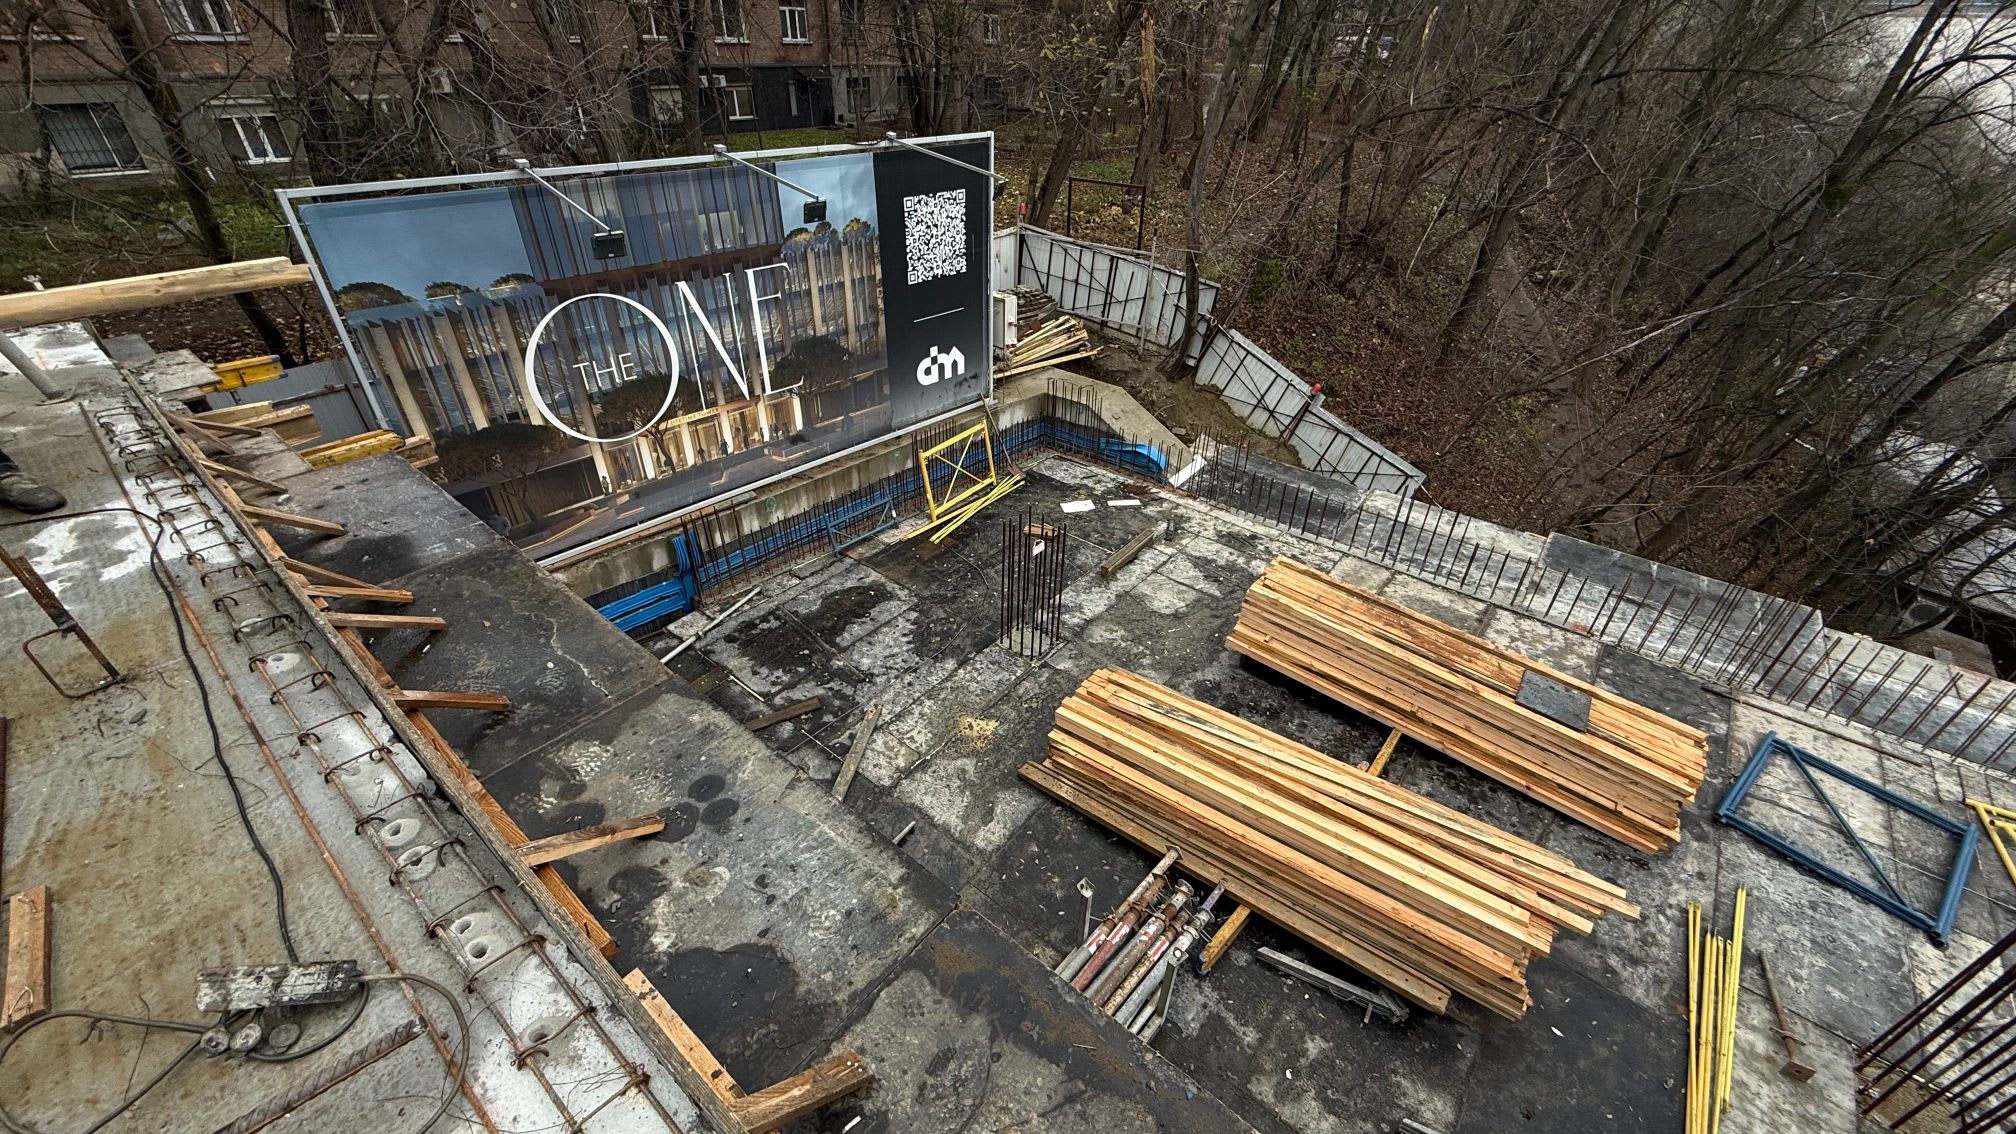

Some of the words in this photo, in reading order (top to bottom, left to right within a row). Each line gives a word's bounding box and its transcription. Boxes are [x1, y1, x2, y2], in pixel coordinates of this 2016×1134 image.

[524, 262, 804, 443] ONE
[572, 352, 638, 390] THE
[670, 414, 696, 425] LIFETIME
